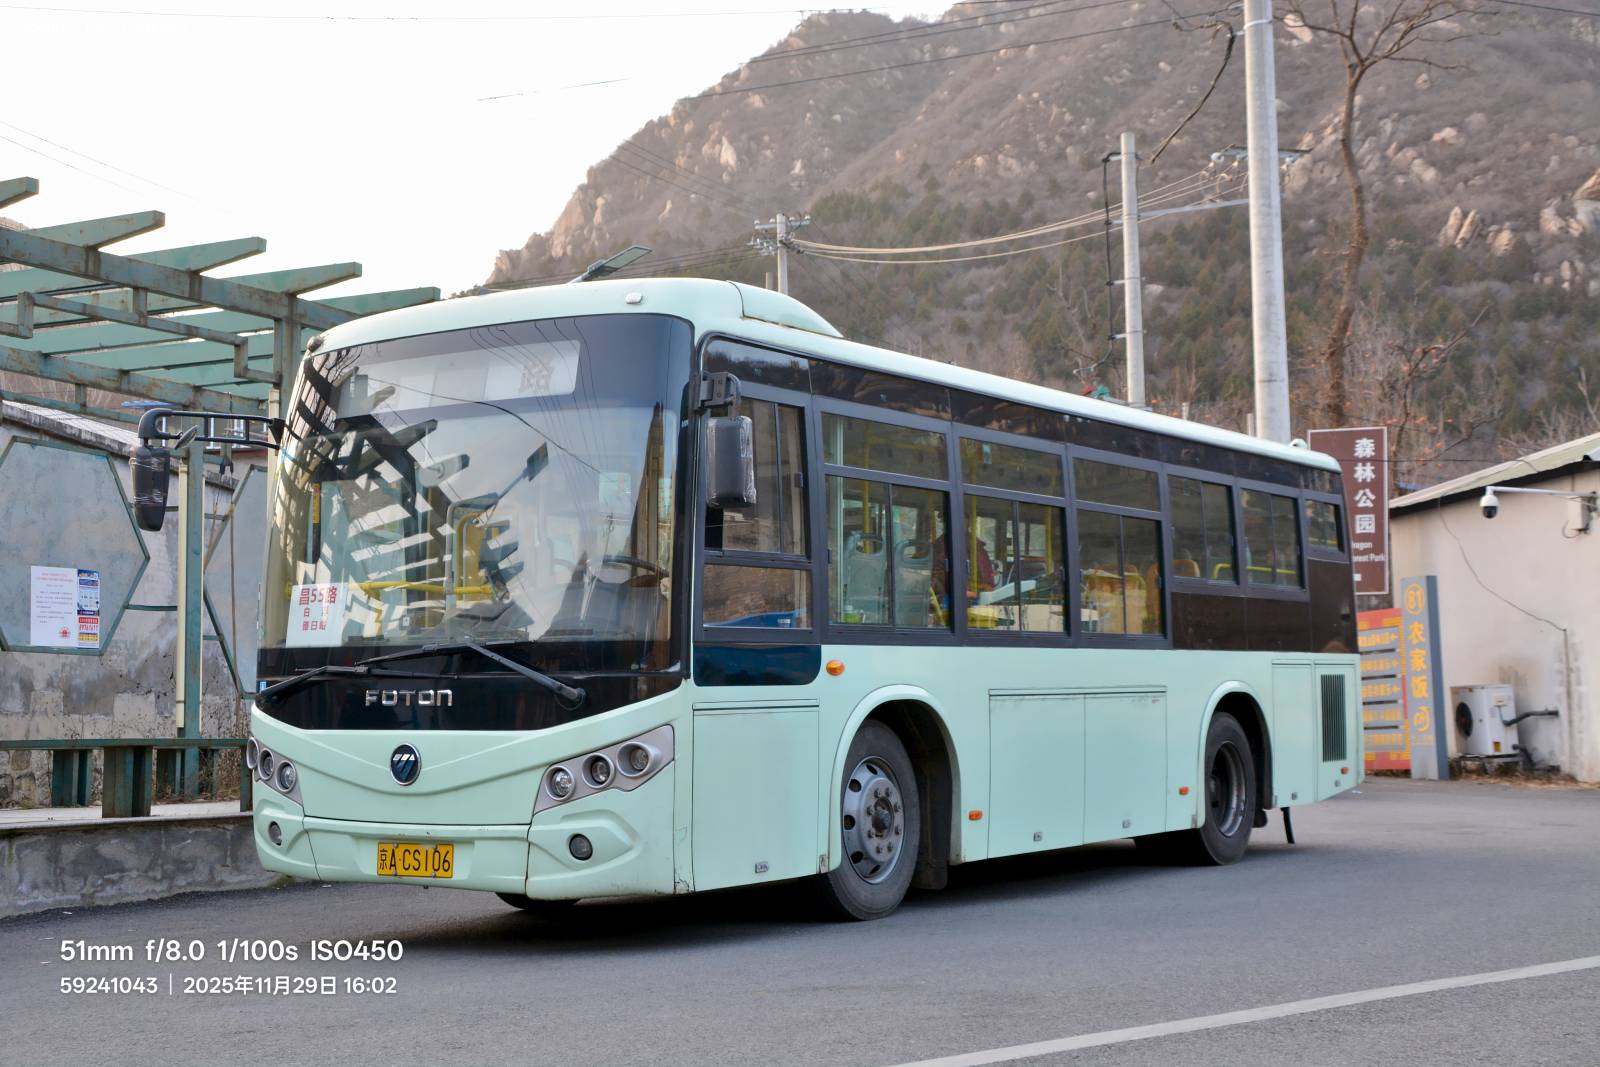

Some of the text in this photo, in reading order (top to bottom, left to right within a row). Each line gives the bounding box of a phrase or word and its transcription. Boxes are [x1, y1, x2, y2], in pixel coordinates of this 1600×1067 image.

[1354, 438, 1376, 534] 森林公园
[1352, 541, 1373, 551] ragon
[1352, 554, 1368, 562] orest
[299, 586, 337, 605] 昌55路
[365, 689, 453, 707] FOTON
